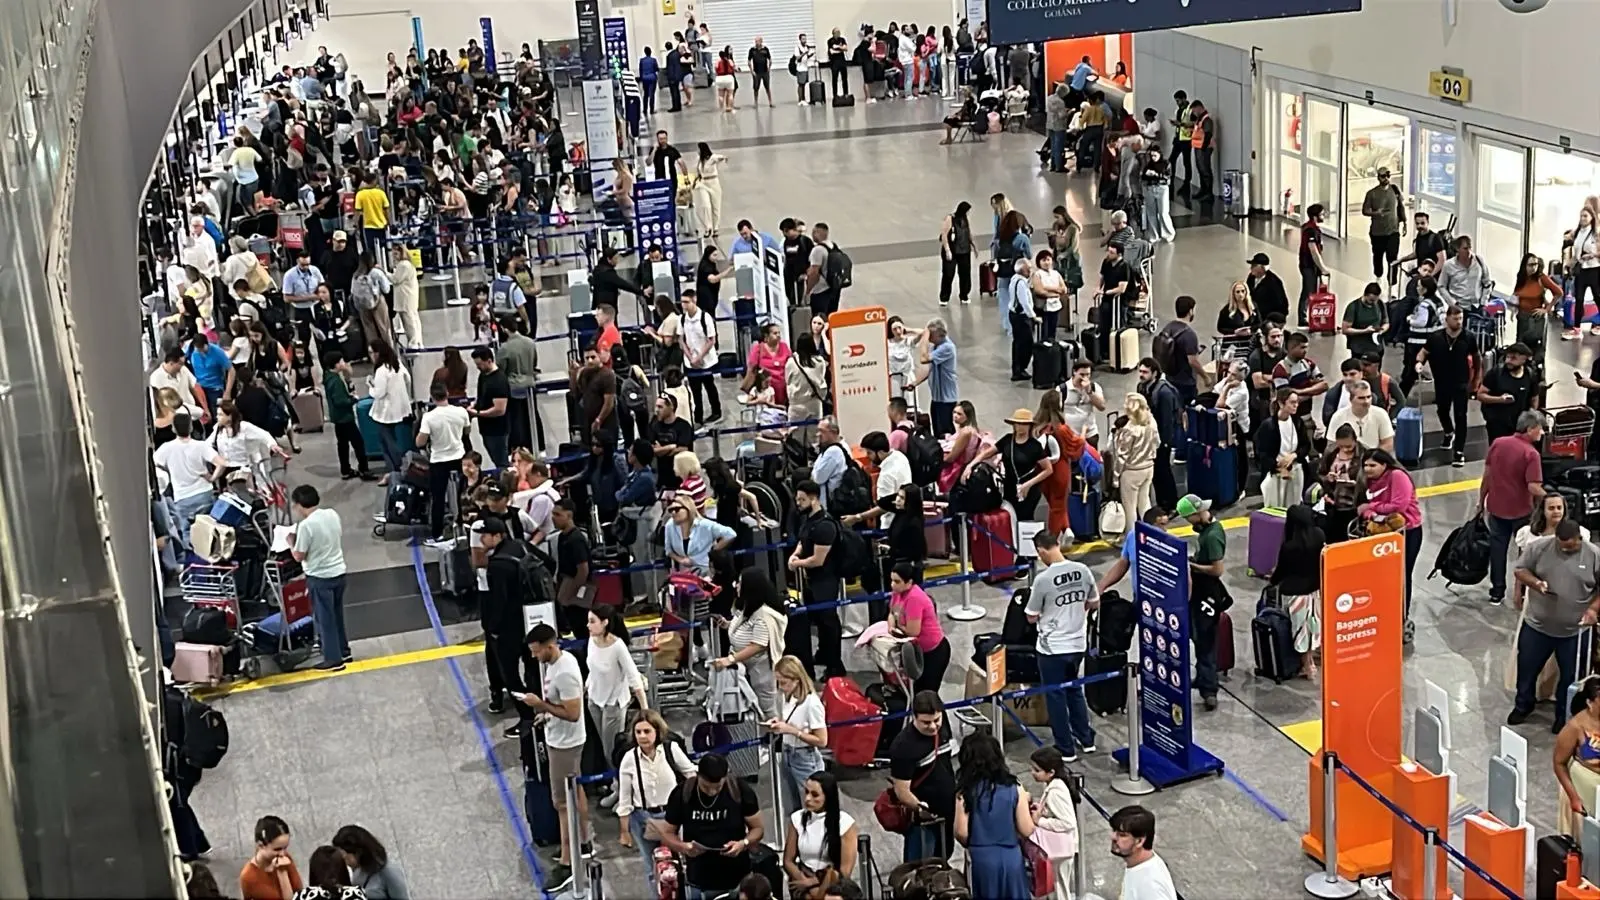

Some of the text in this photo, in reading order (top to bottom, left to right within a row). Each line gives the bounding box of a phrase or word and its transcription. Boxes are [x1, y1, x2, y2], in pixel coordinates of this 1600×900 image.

[864, 311, 885, 322] GOL
[1372, 541, 1401, 557] GOL
[1053, 571, 1082, 586] CBVD
[1336, 616, 1377, 631] Bagagem
[1336, 628, 1377, 643] Expressa
